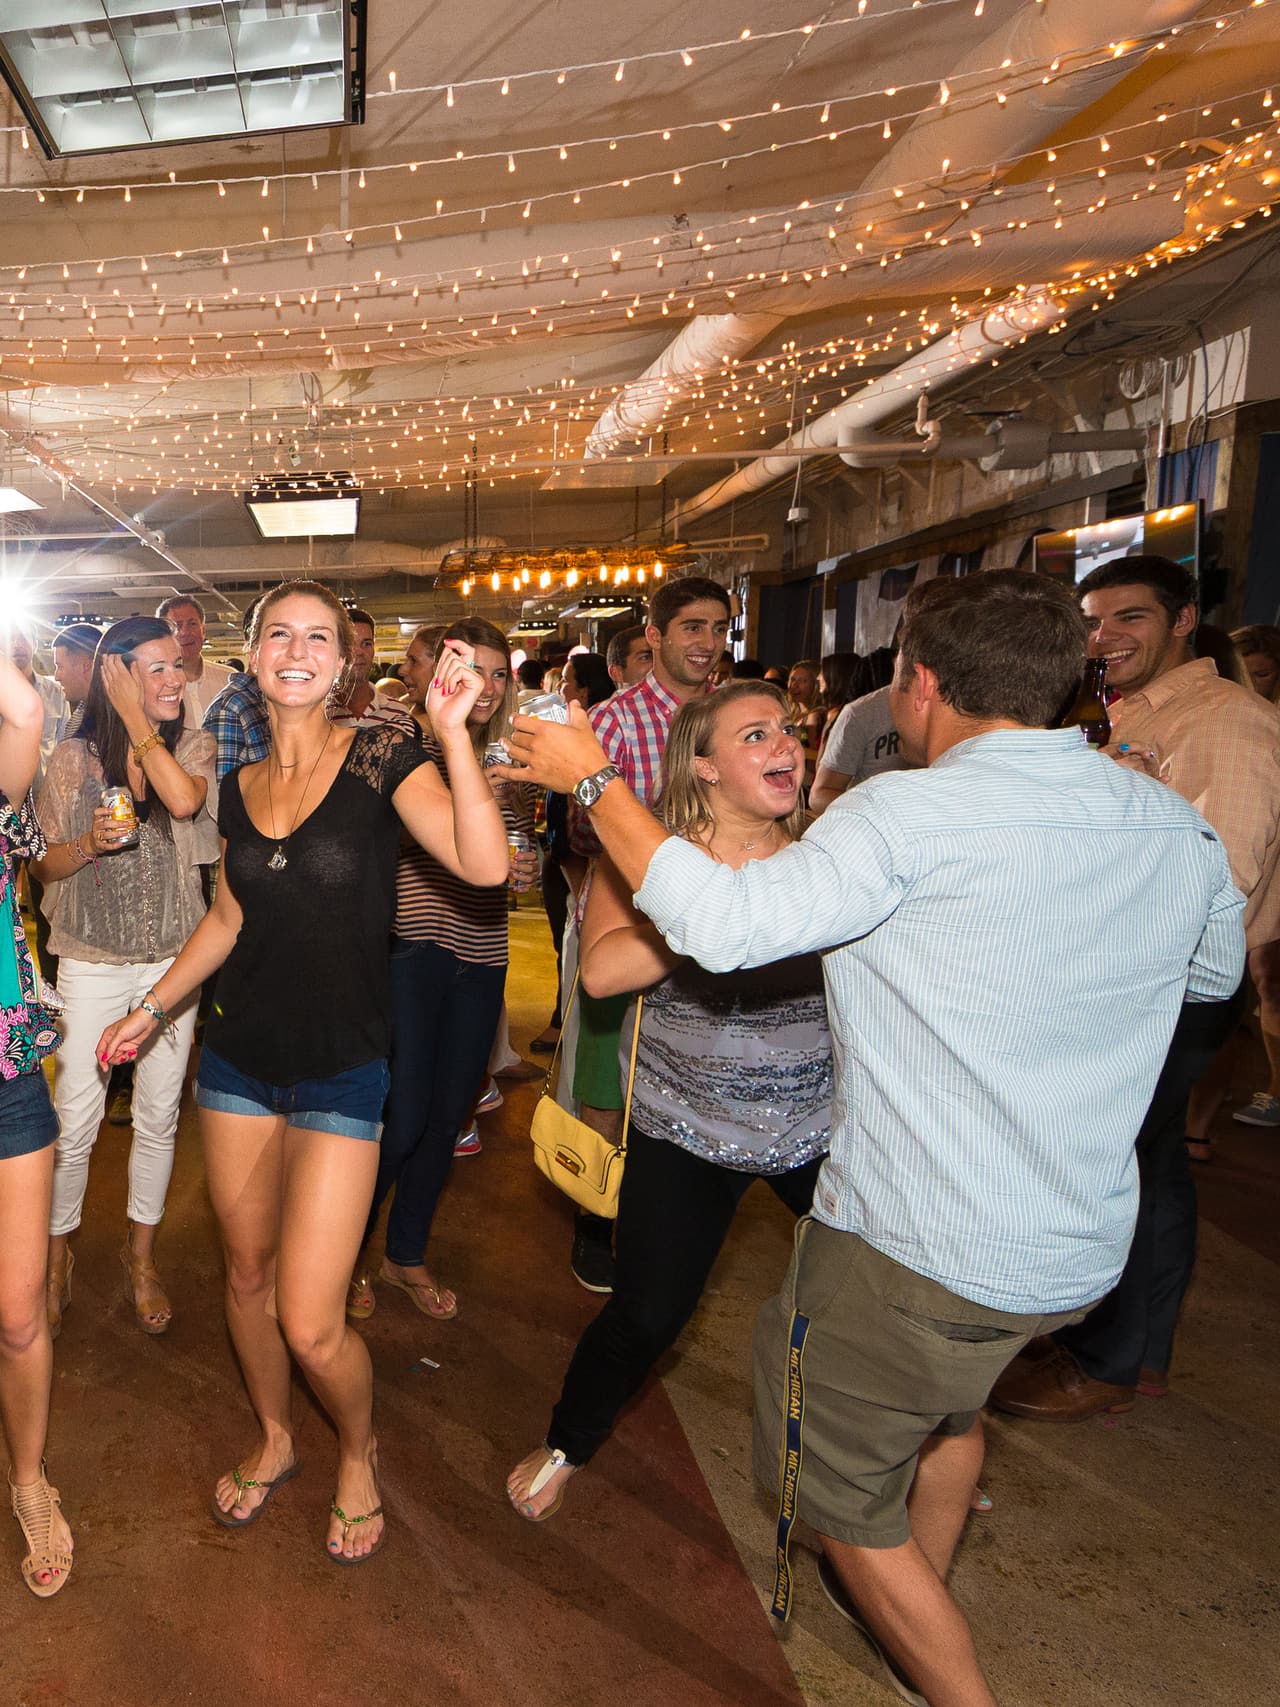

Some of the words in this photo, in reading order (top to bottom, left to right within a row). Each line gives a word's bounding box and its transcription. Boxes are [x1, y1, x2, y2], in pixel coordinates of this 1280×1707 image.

[789, 1346, 801, 1420] MICHIGAN
[782, 1449, 799, 1521] MICHIGAN
[775, 1545, 788, 1612] MICHIGAN
